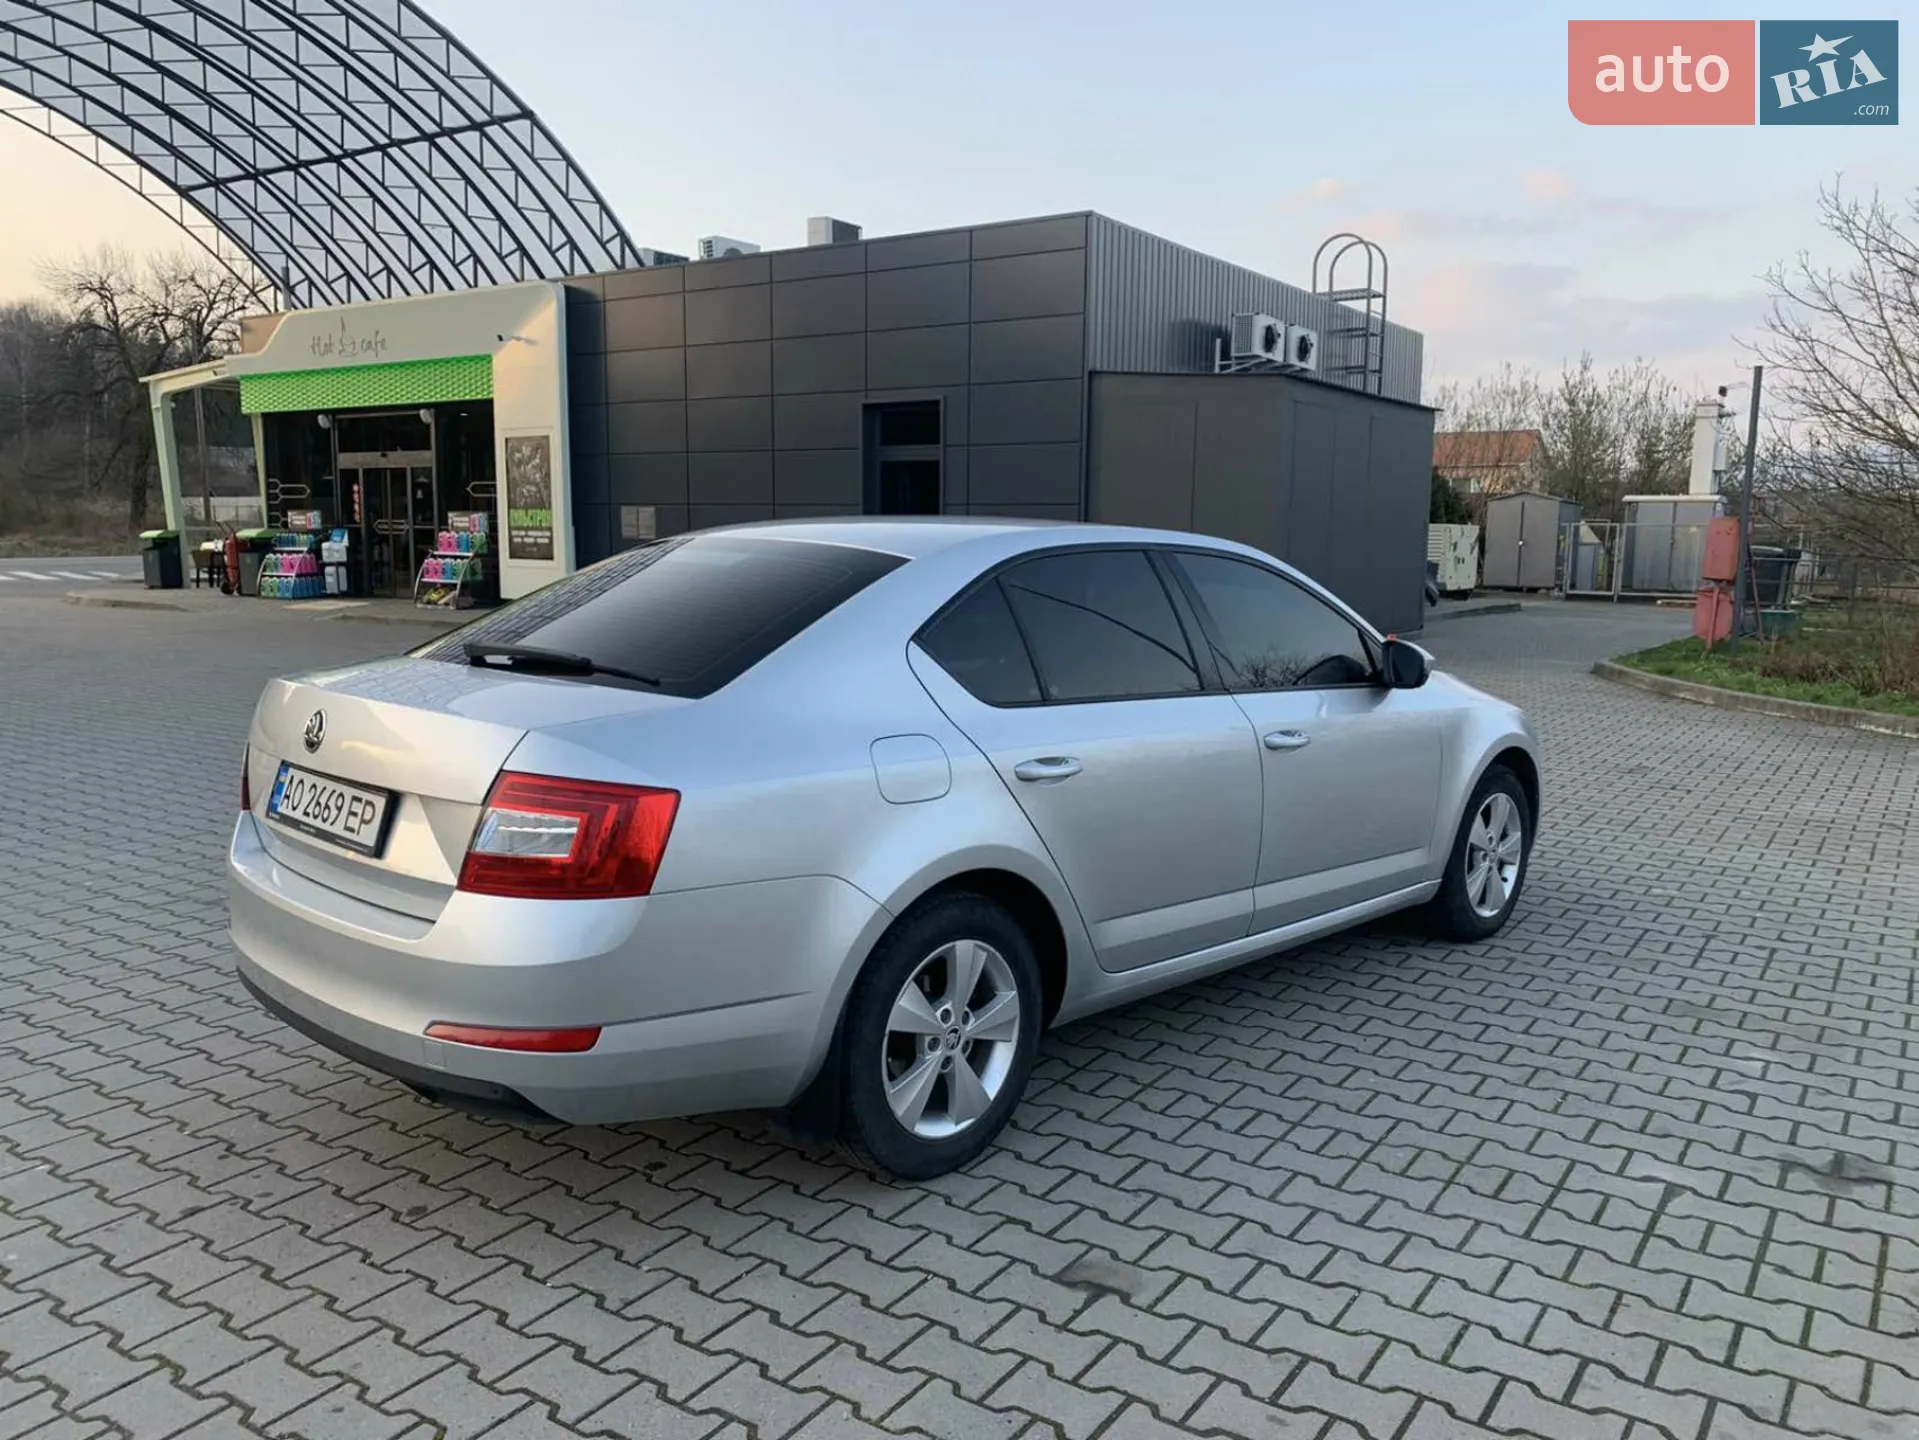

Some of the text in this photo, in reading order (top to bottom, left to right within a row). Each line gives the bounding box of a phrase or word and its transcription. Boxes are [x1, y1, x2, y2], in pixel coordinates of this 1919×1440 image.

[308, 329, 388, 359] Hot cafe
[281, 775, 376, 835] AO 2669 EP
